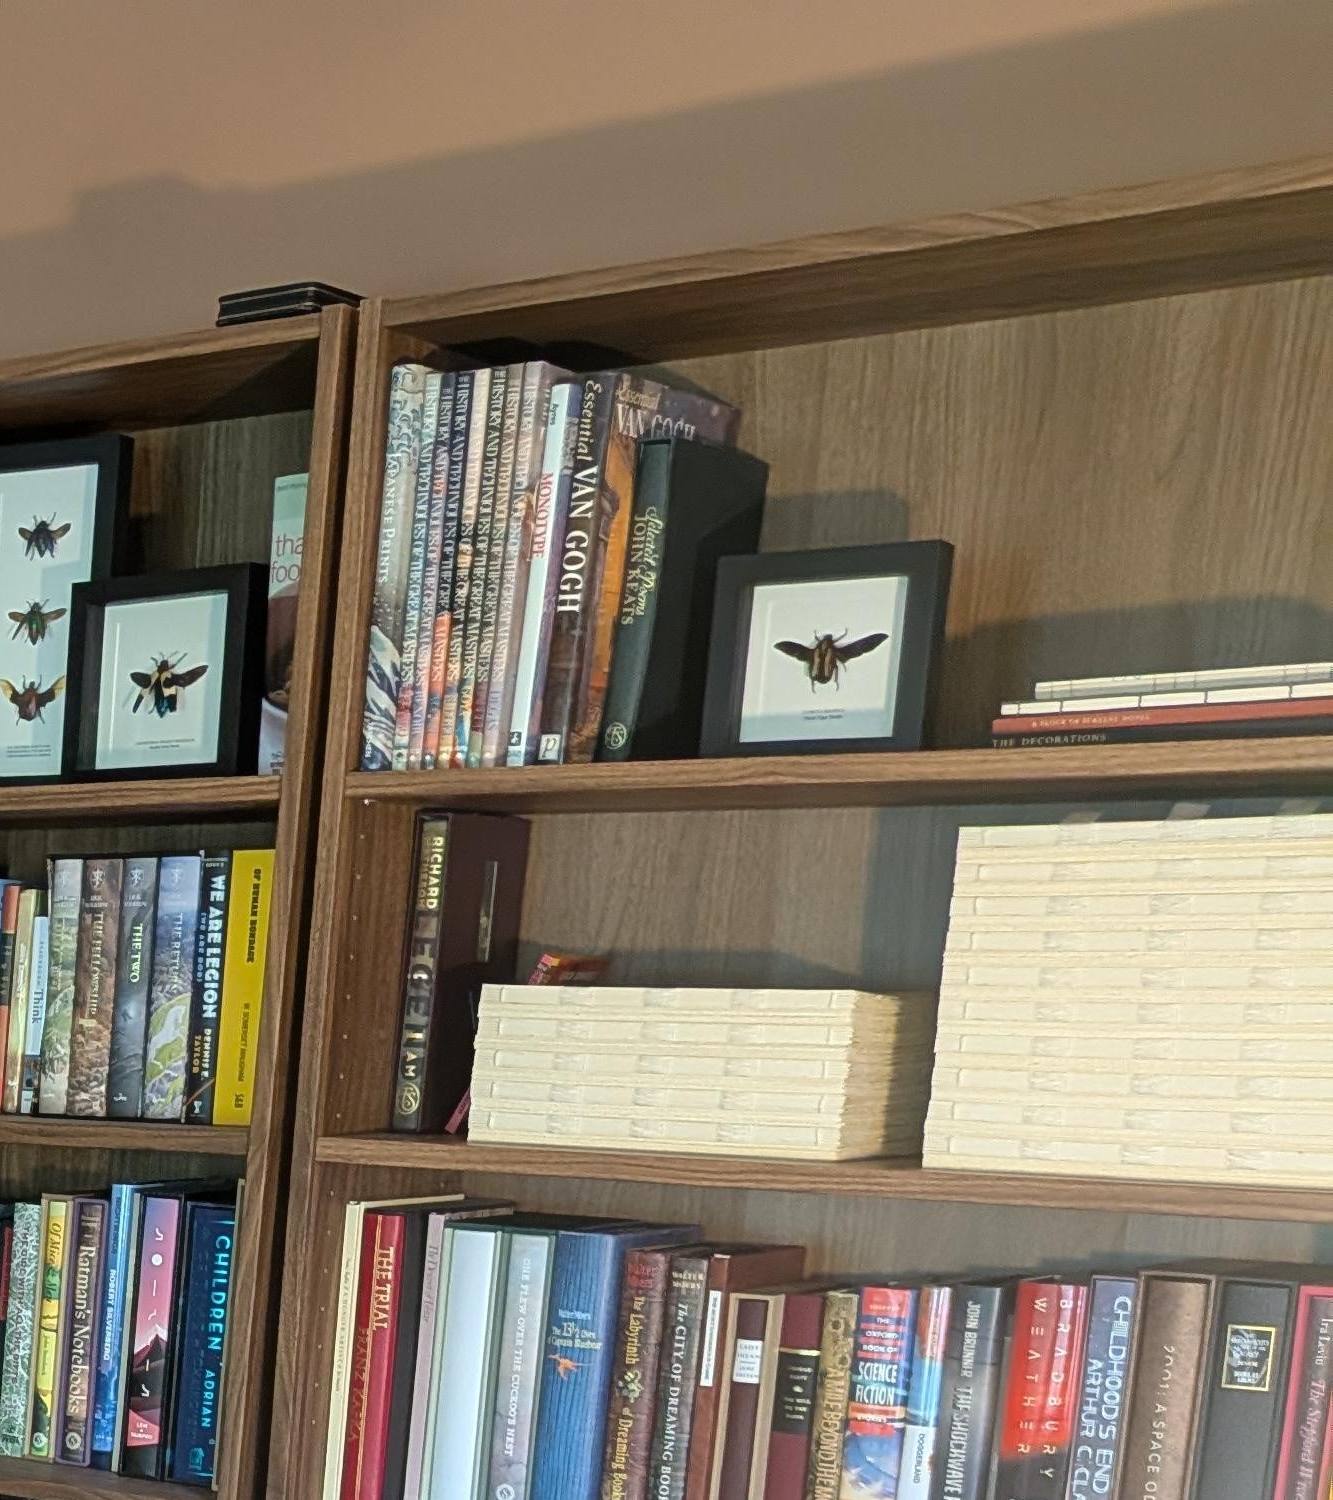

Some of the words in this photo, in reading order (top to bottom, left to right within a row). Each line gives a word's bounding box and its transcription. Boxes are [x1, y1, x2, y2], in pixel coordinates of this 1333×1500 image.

[577, 380, 602, 462] Essential
[532, 472, 554, 559] MONOTYPE
[568, 465, 598, 519] VAN
[556, 530, 588, 614] GOGH
[208, 874, 226, 902] WE
[206, 906, 222, 944] ARE
[202, 948, 221, 1018] LEGION
[75, 1245, 96, 1320] Ratman's
[207, 1235, 231, 1350] CHILDREN
[375, 1246, 394, 1281] THE
[372, 1283, 391, 1331] TRIAL
[676, 1303, 688, 1323] The
[67, 1324, 89, 1414] Notebooks
[672, 1325, 686, 1360] CITY
[1099, 1296, 1133, 1440] CHILDHOOD'S
[201, 1369, 215, 1428] ADRIAN
[670, 1363, 683, 1383] OF
[1080, 1358, 1103, 1437] ARTHUR
[661, 1386, 681, 1462] DREAMING
[1155, 1403, 1167, 1413] A
[943, 1413, 972, 1494] SHOCKWAVE
[1092, 1449, 1114, 1494] END
[1147, 1420, 1166, 1473] SPACE
